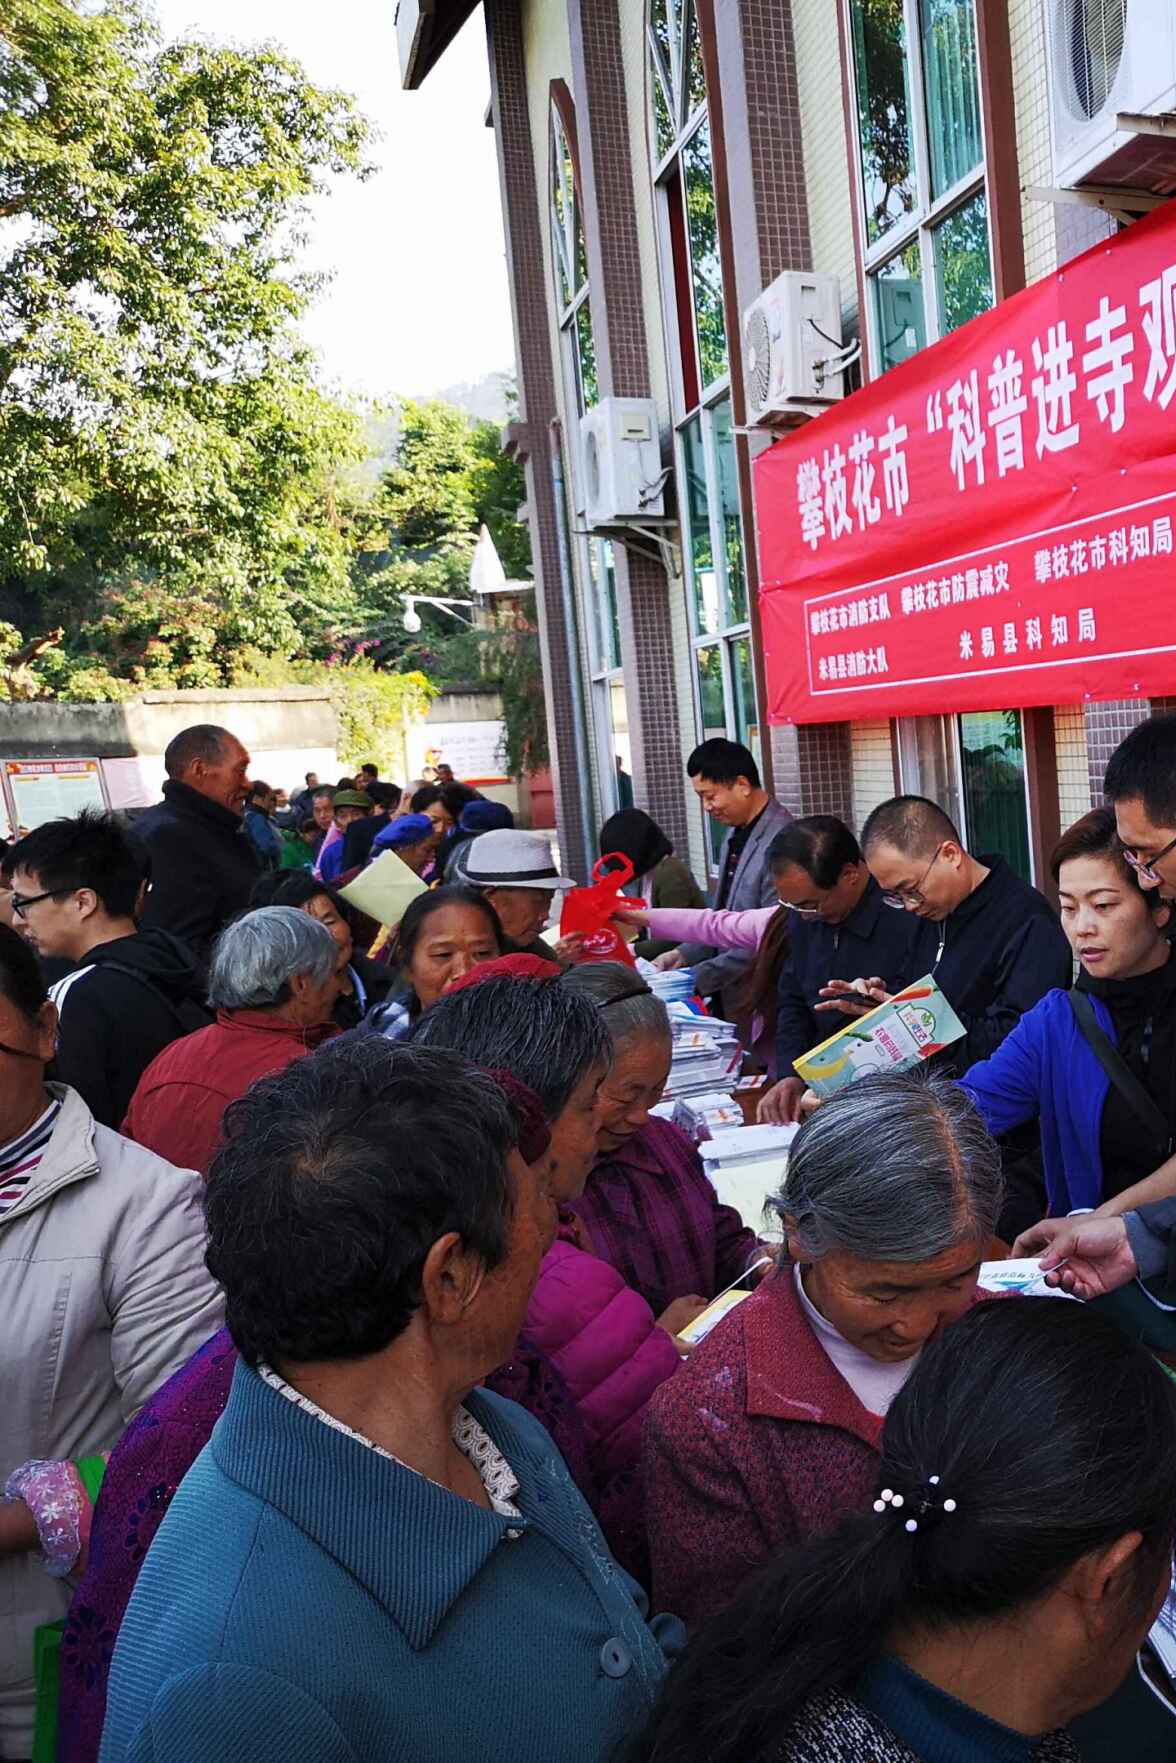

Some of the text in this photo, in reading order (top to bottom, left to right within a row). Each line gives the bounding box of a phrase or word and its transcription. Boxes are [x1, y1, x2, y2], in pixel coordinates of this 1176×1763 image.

[901, 561, 1010, 615] 攀枝花市防震减灾
[1034, 516, 1173, 584] 攀枝花市科知局
[959, 607, 1097, 660] 米易县科知局
